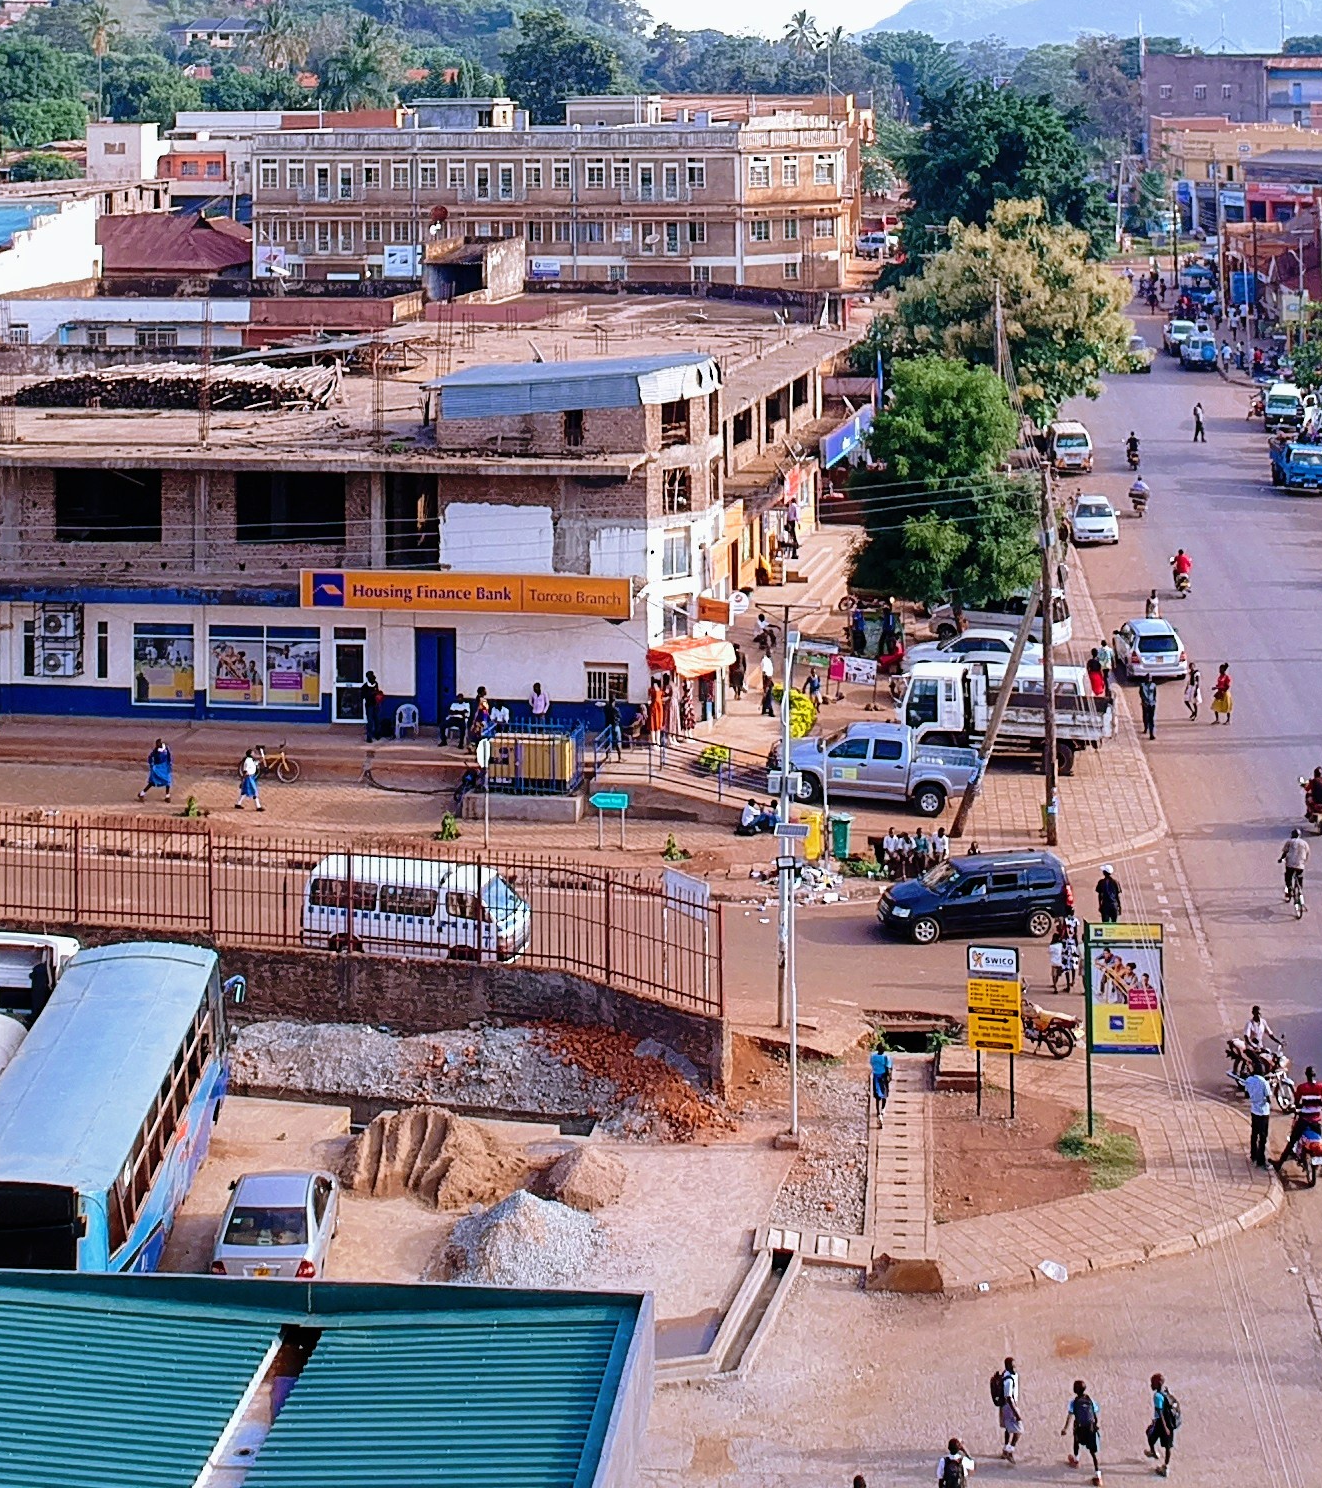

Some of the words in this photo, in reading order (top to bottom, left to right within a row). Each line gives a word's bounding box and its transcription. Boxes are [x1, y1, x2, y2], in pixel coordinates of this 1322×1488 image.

[352, 583, 412, 602] Housing
[416, 585, 472, 601] Finance
[476, 586, 512, 601] Bank
[529, 588, 572, 604] Tororo
[576, 591, 621, 607] Branch
[985, 956, 1014, 965] SWICO
